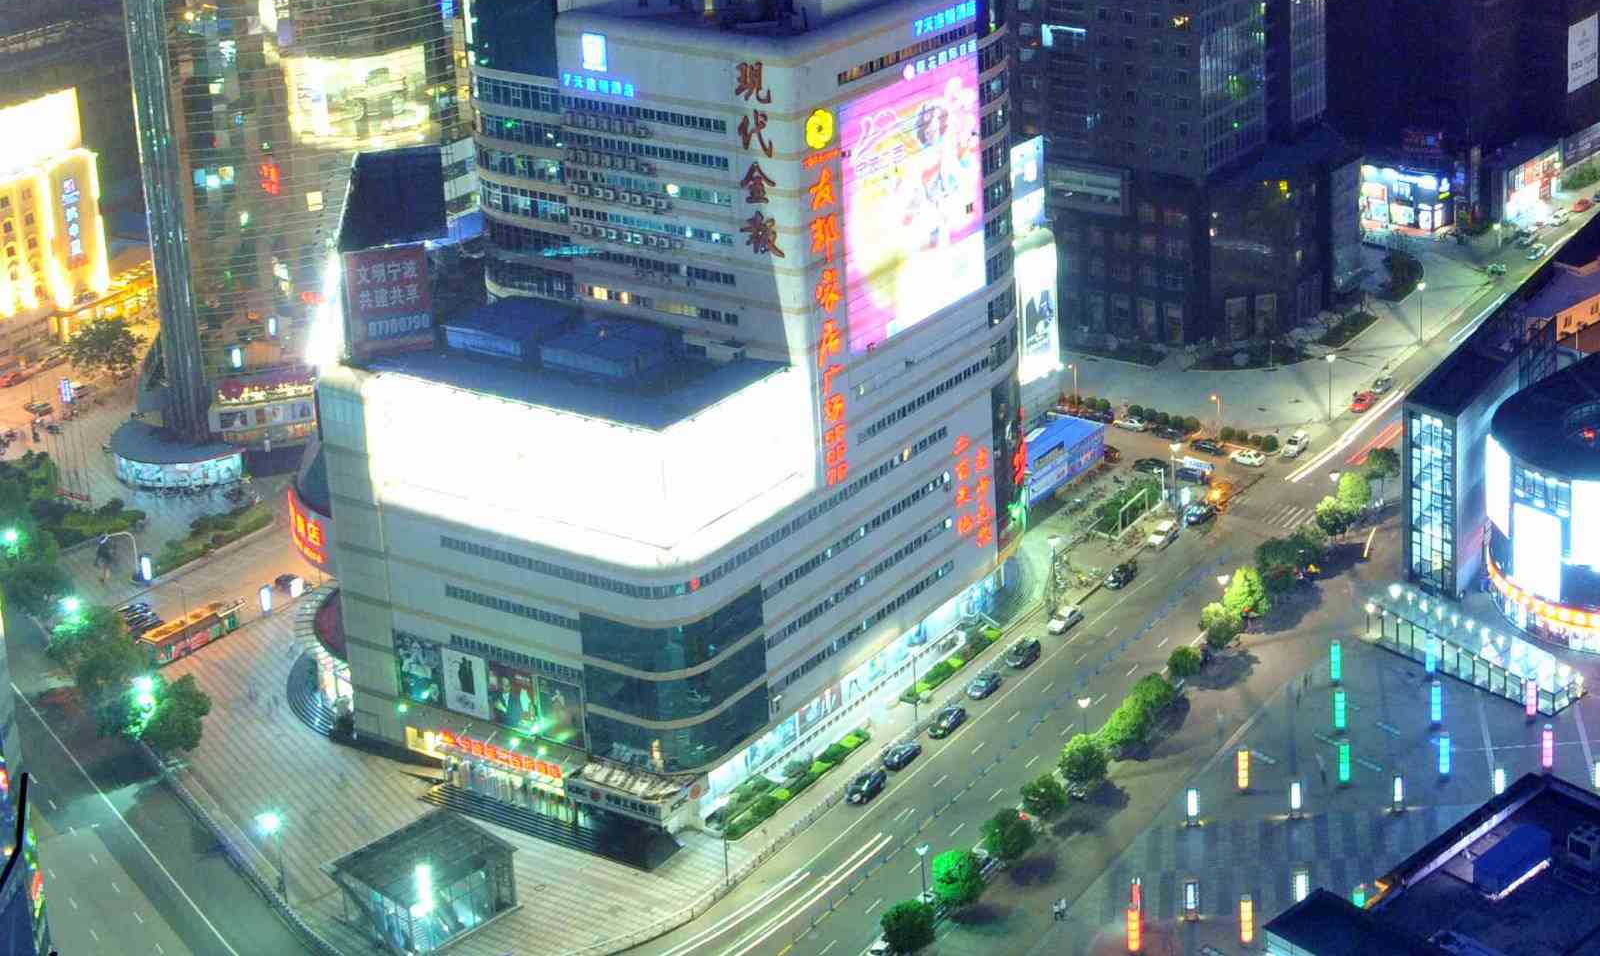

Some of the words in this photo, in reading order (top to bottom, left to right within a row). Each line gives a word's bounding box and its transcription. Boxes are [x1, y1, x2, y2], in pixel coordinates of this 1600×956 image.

[736, 60, 785, 258] 现代金报
[356, 260, 417, 284] 文明宁波
